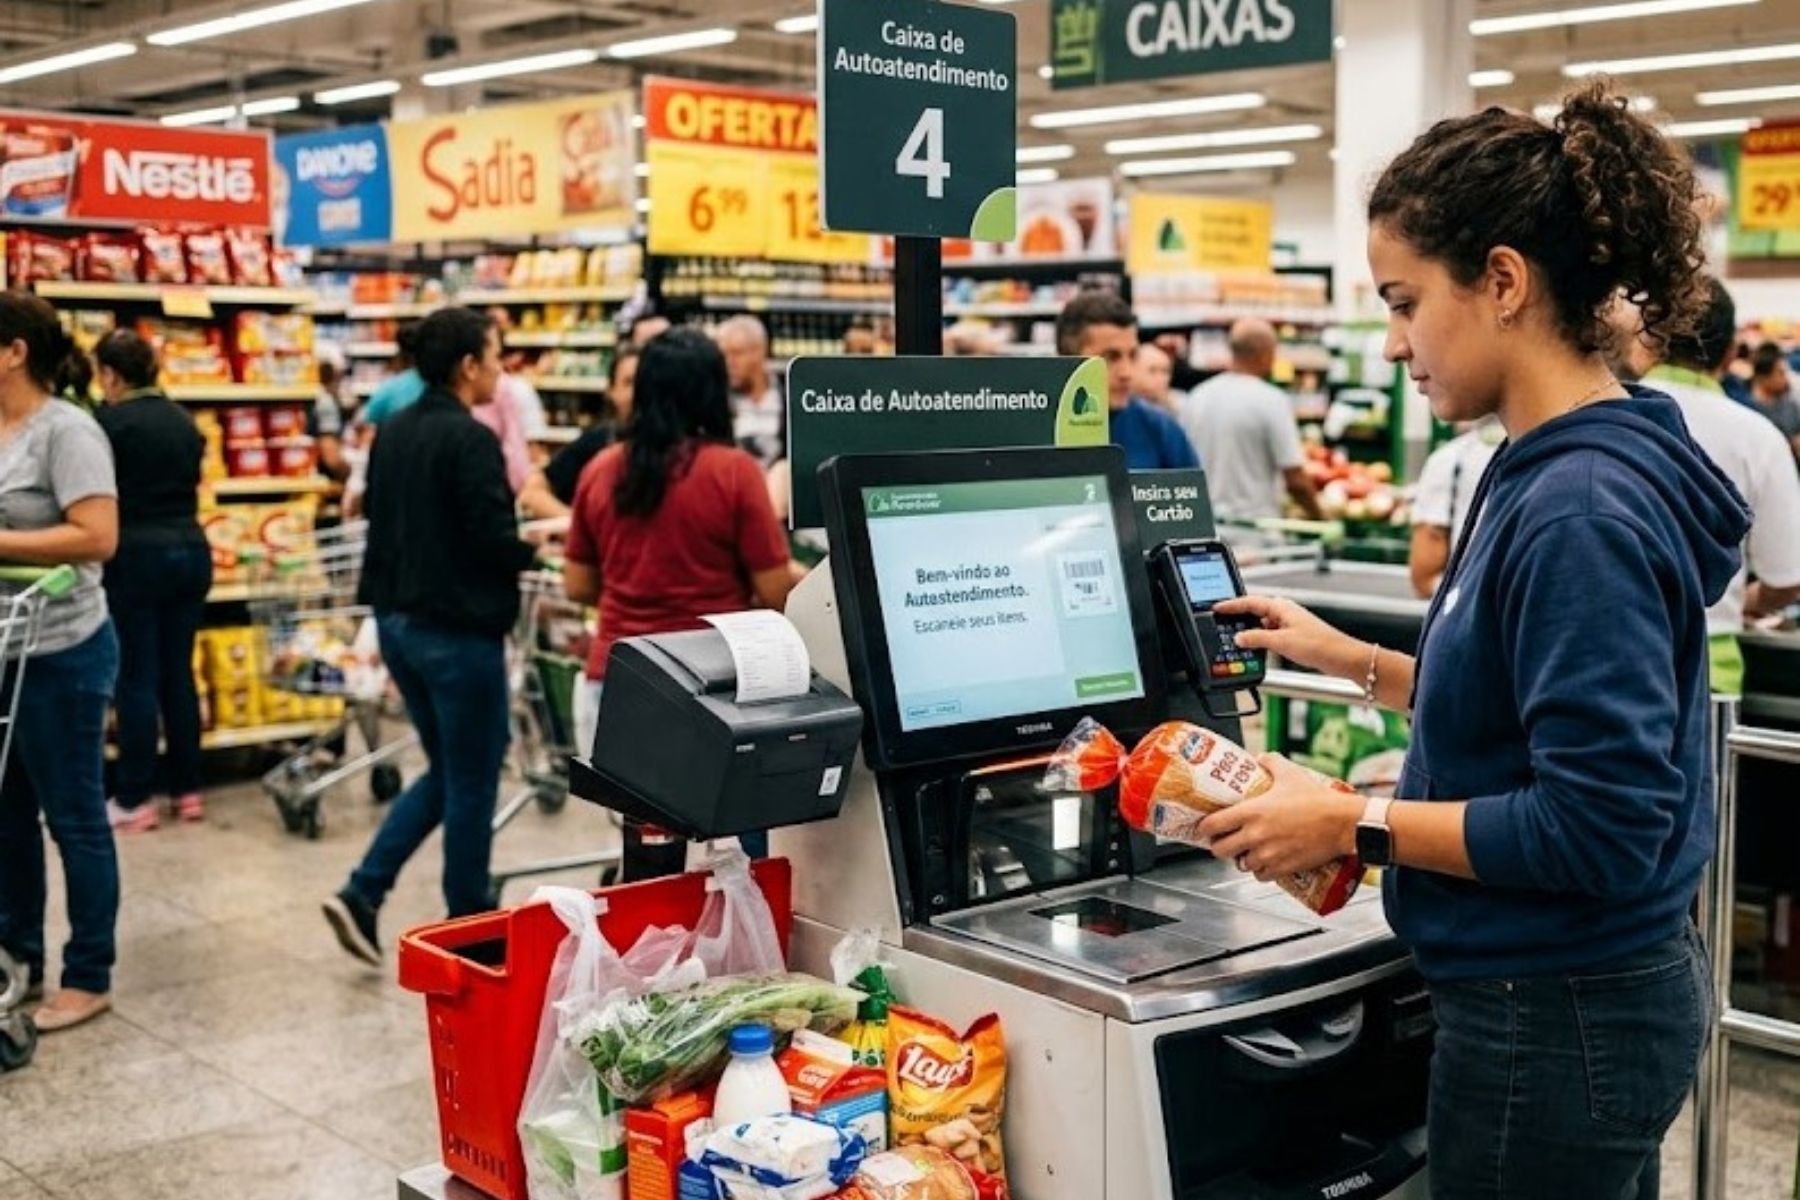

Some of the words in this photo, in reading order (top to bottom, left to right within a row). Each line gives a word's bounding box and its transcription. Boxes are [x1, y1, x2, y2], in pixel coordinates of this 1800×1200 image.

[881, 20, 937, 50] Caixa
[940, 30, 965, 54] de
[1126, 0, 1296, 58] CAIXAS
[834, 46, 1009, 91] Autoatendimento
[420, 126, 536, 222] Sadia
[895, 107, 951, 199] 4
[801, 389, 855, 412] Caixa
[859, 389, 884, 411] de
[888, 387, 1048, 411] Autoatendimento
